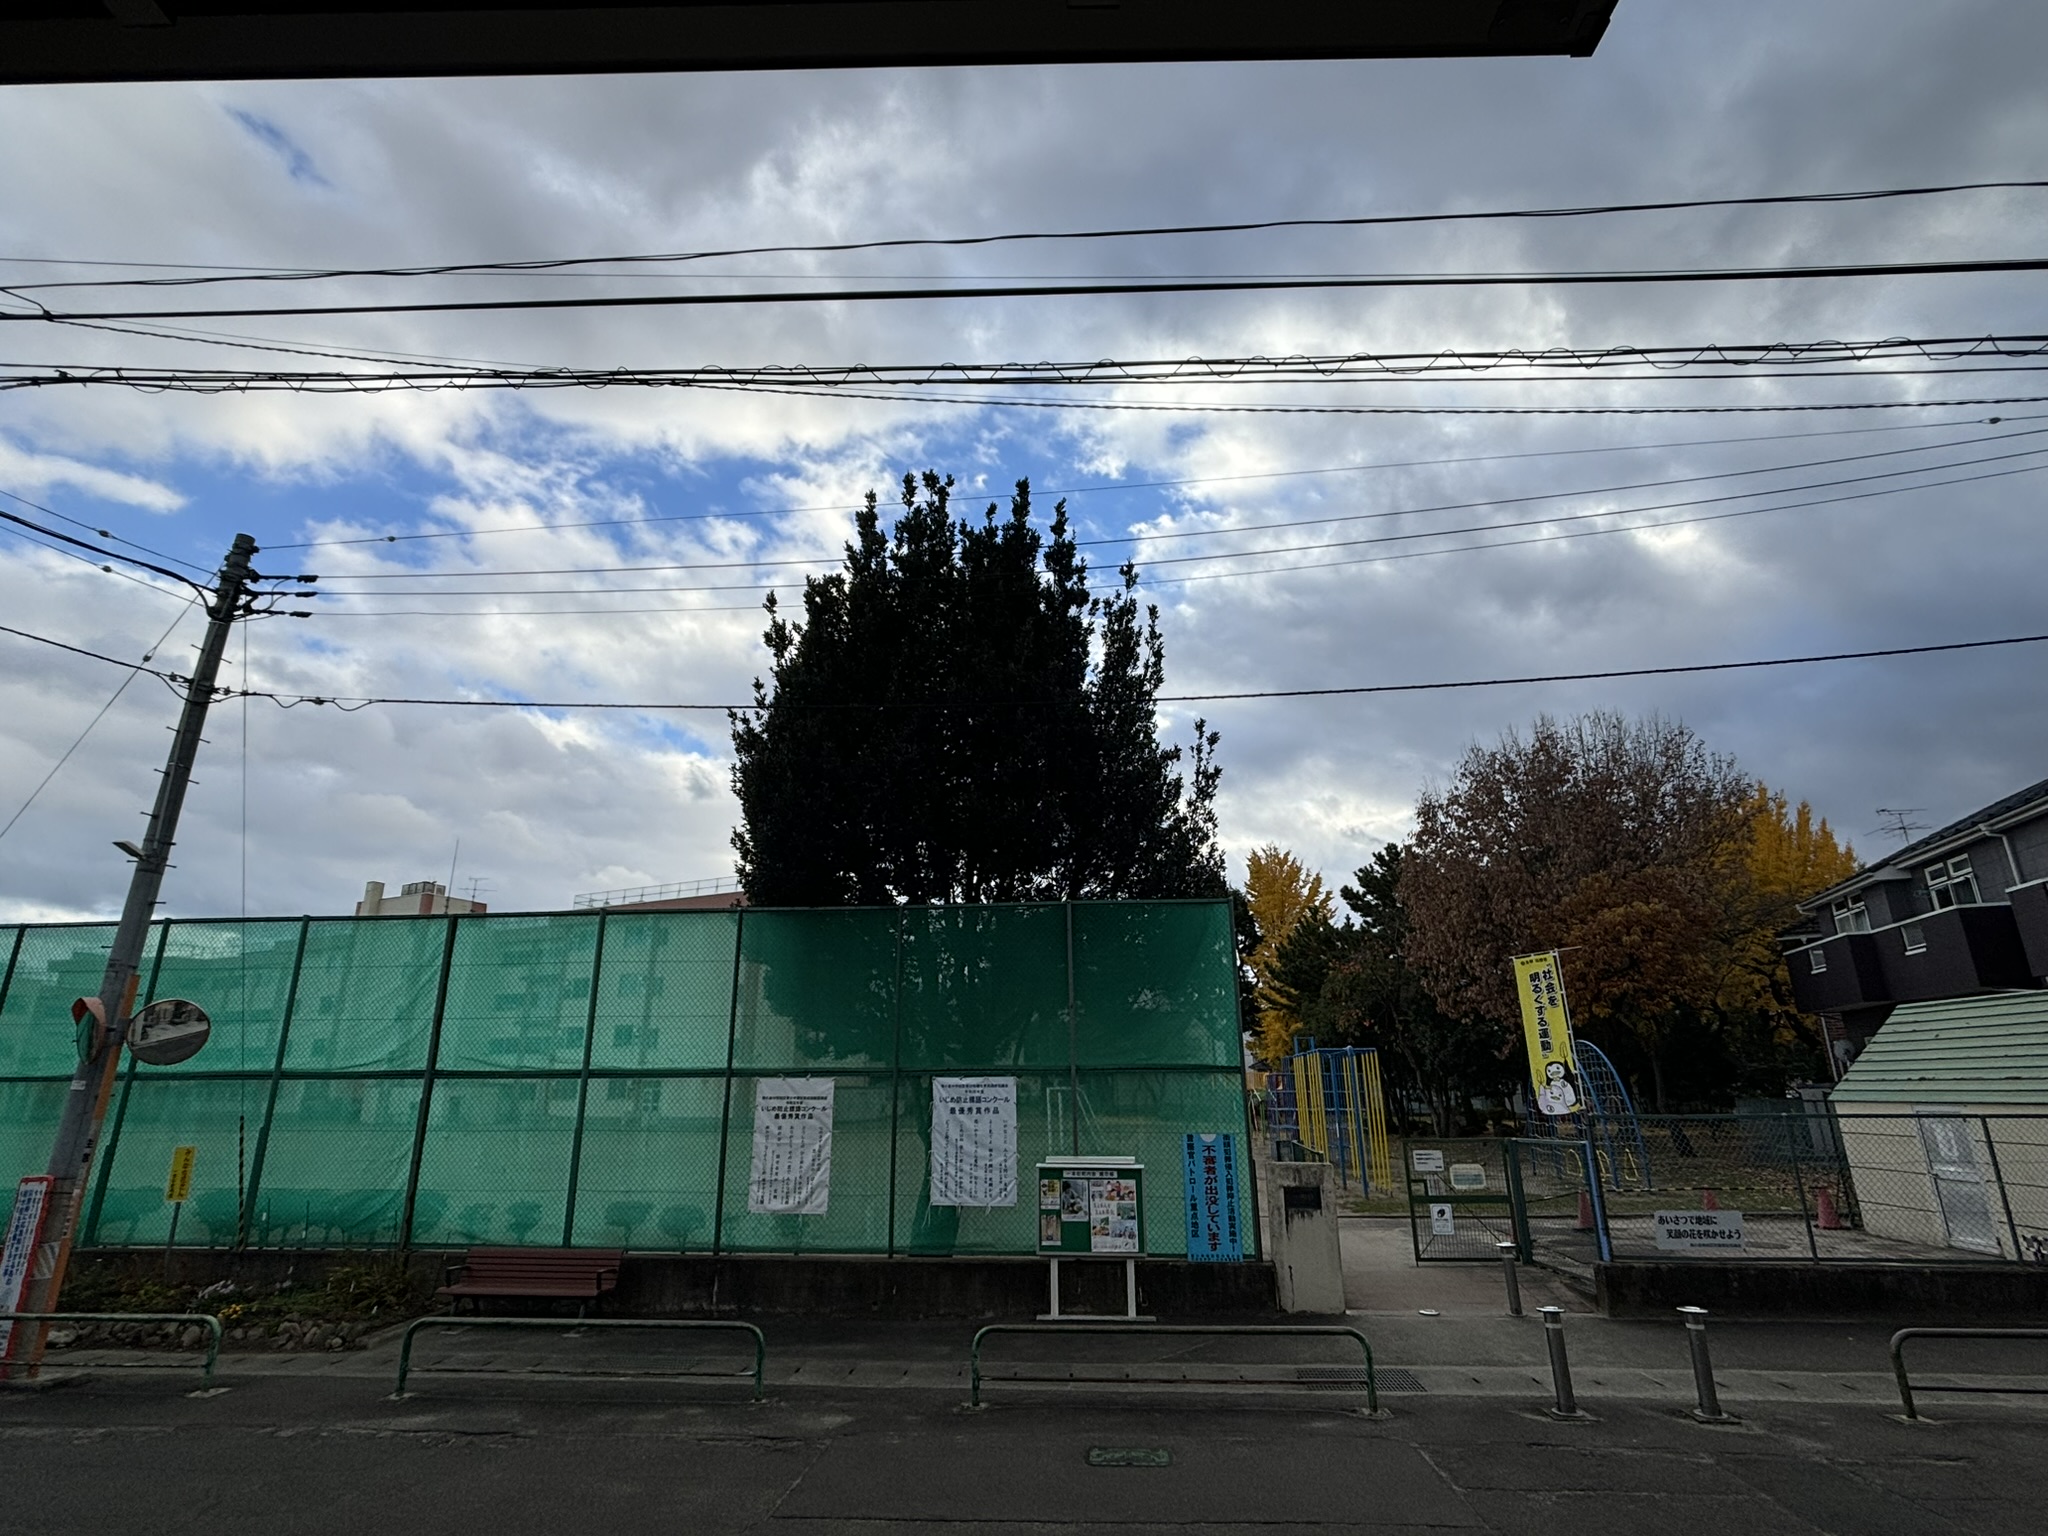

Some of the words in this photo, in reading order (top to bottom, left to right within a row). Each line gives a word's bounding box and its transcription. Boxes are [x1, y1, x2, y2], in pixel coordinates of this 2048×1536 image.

[949, 1106, 1000, 1115] 最優秀賞作品
[1186, 1134, 1200, 1238] 警察官パトロール重点地区
[1202, 1145, 1222, 1252] 不審者が出没しています
[1657, 1215, 1718, 1225] あいさつで地域に
[1666, 1228, 1742, 1239] 笑顔の花を咲かせよう
